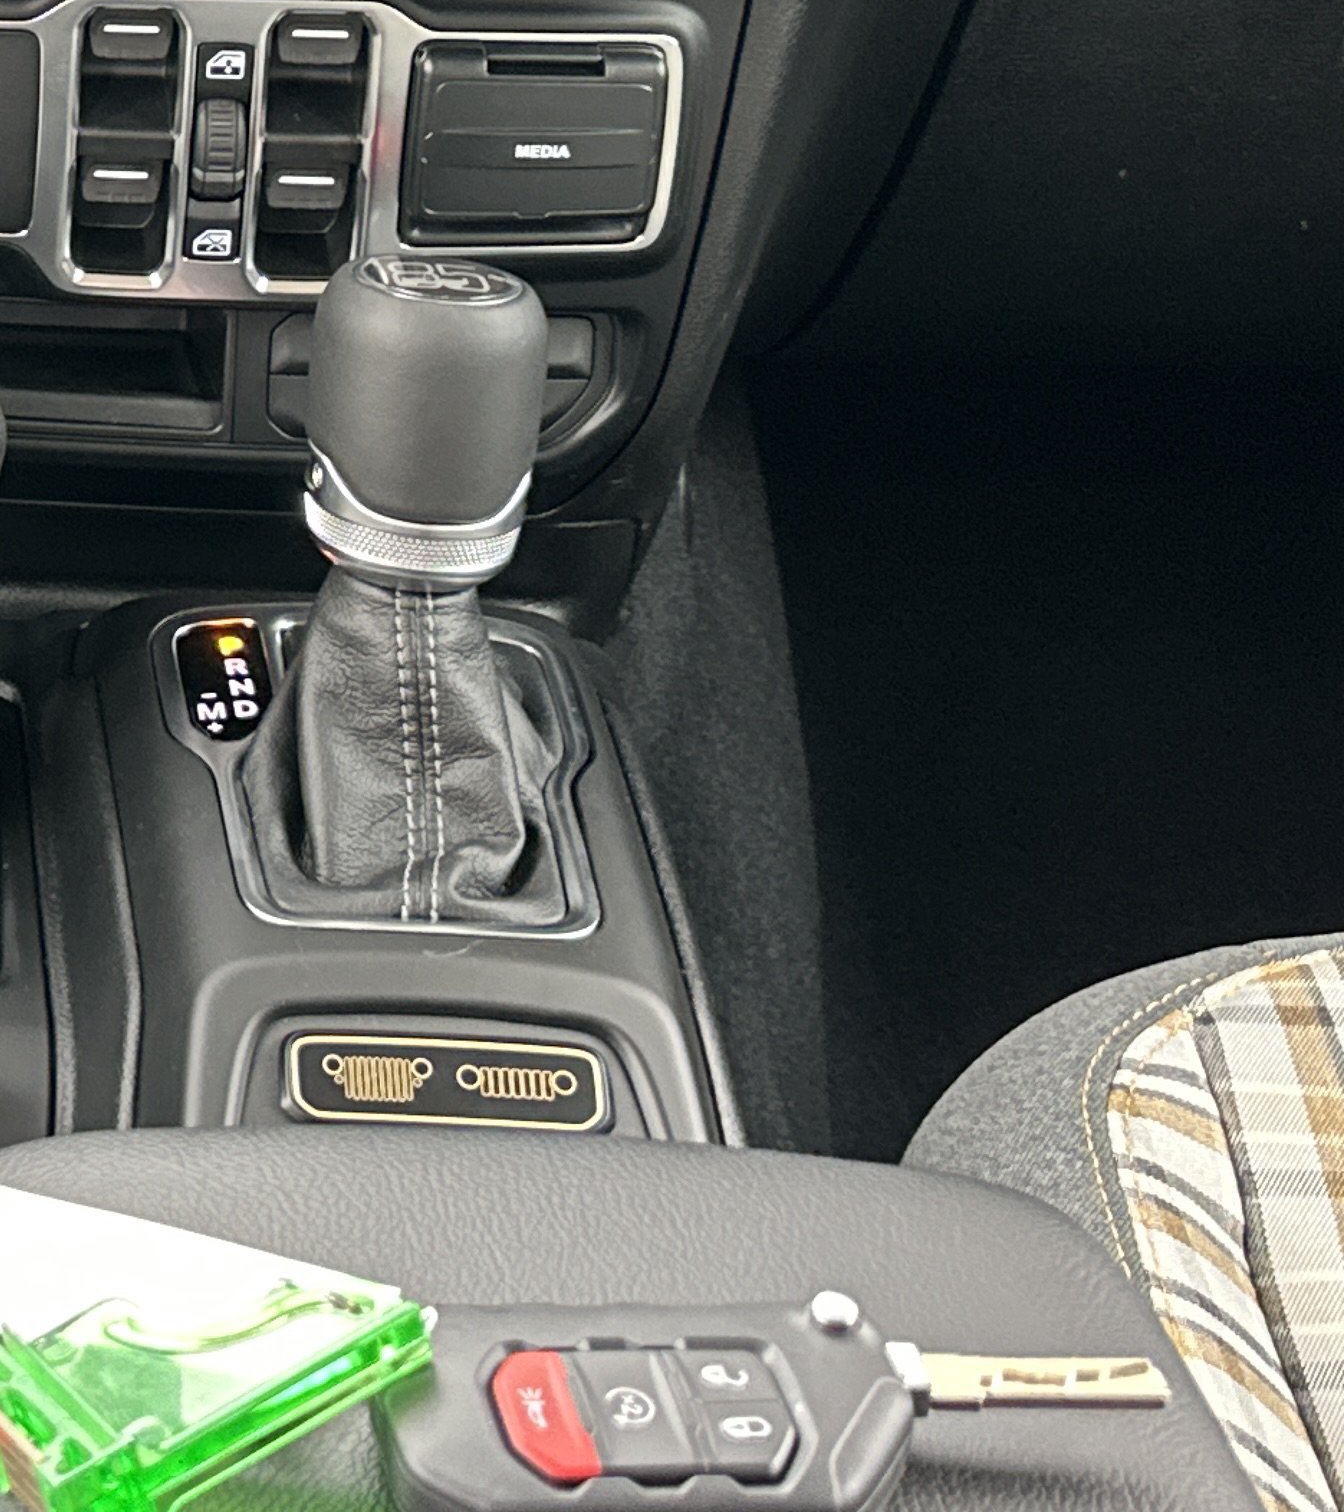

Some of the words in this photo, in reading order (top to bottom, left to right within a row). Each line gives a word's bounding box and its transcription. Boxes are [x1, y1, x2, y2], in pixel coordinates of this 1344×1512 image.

[514, 144, 572, 159] MEDIA
[223, 657, 249, 676] R
[228, 677, 255, 697] N
[196, 701, 227, 721] M
[232, 699, 259, 718] D
